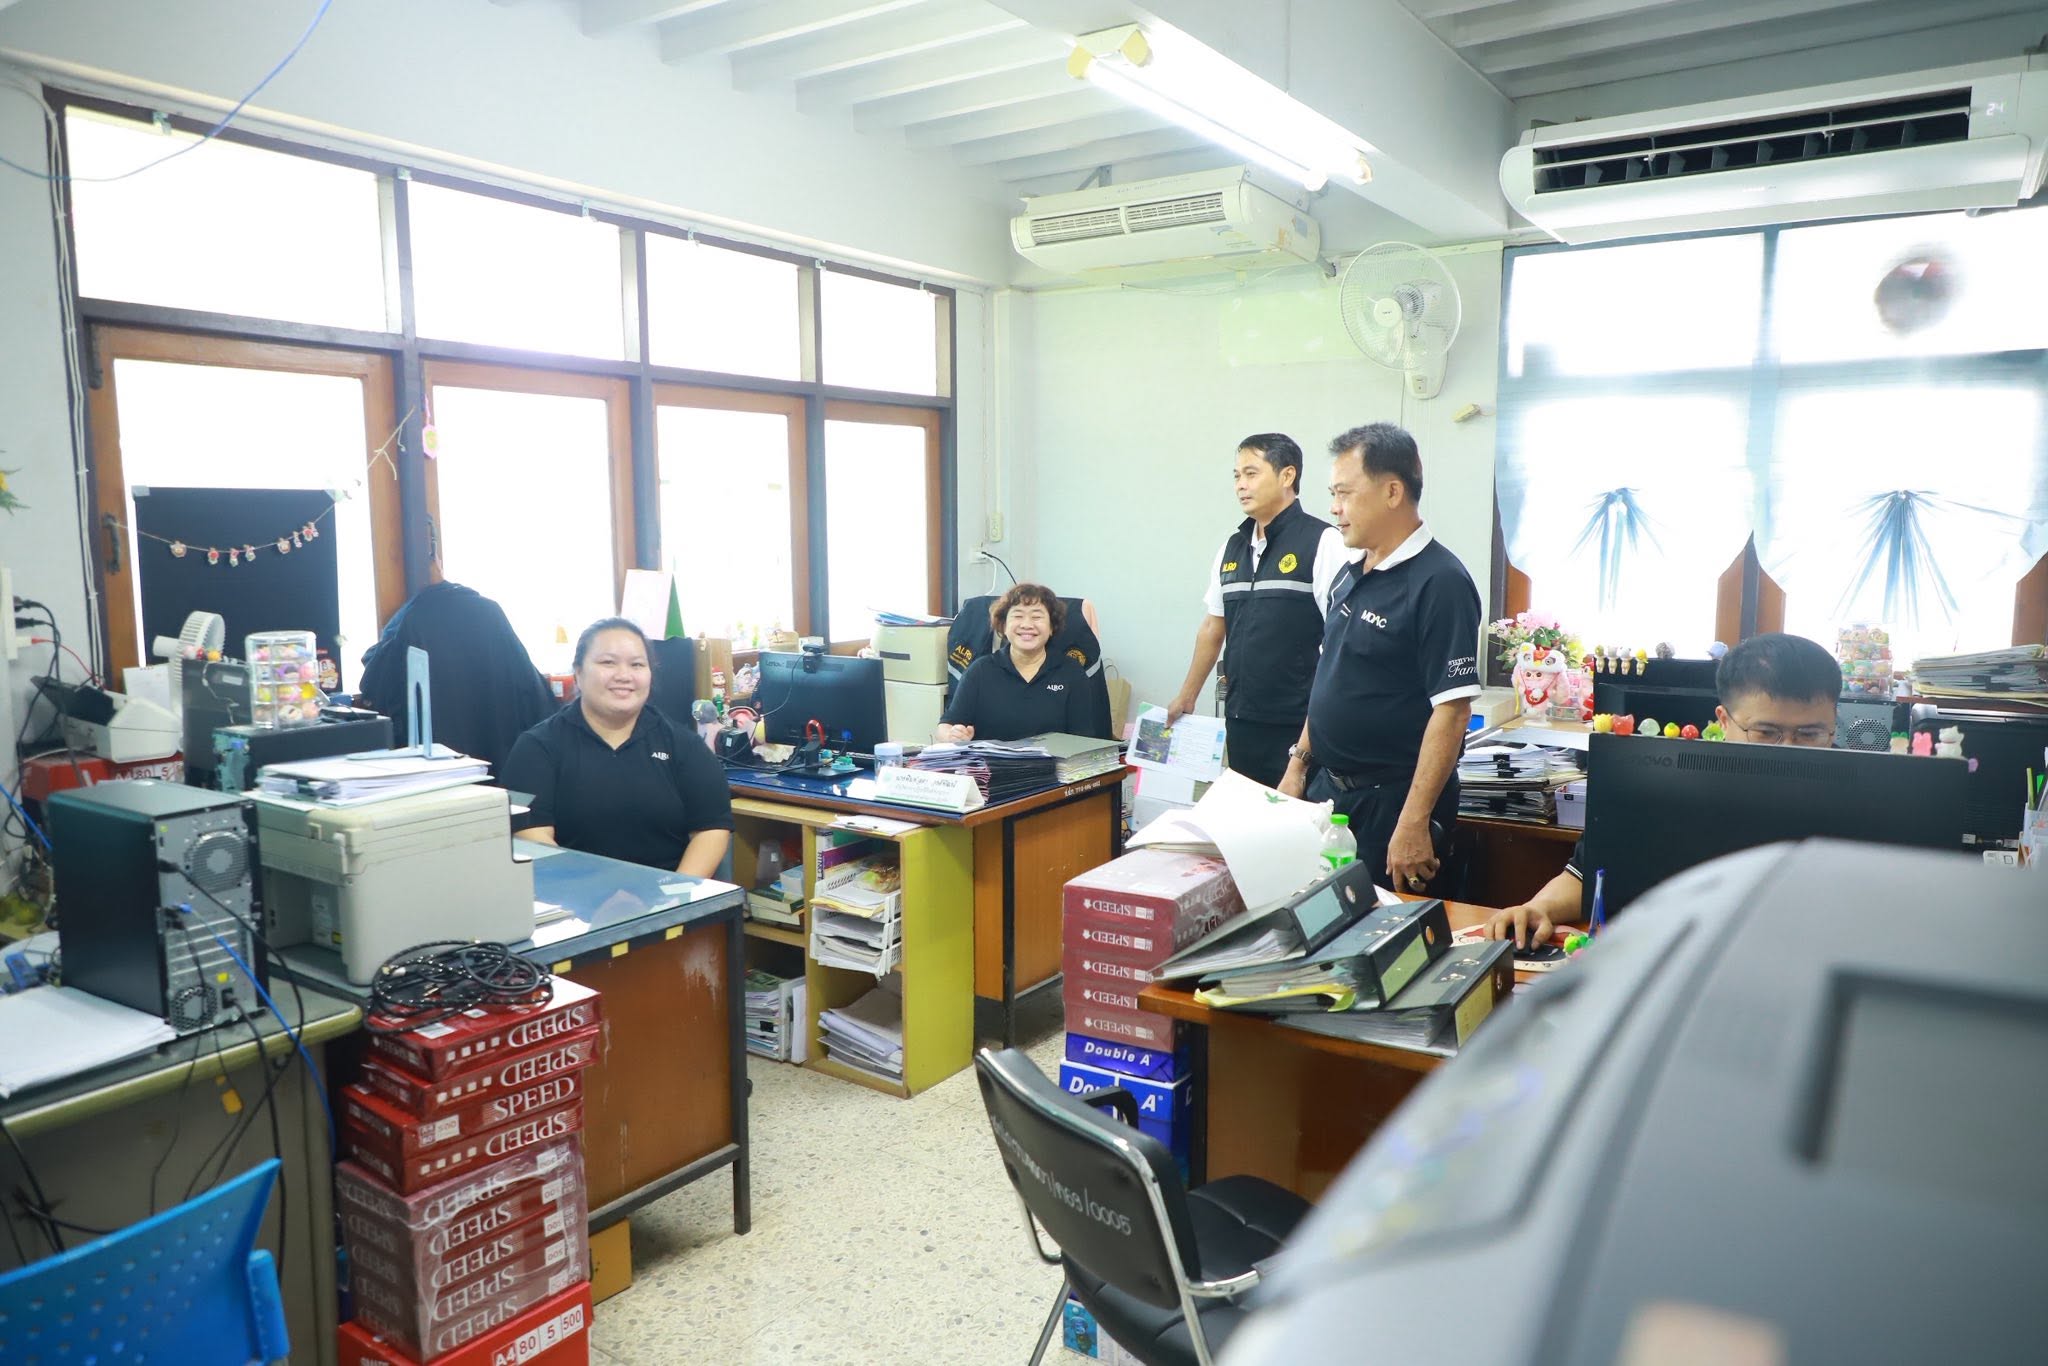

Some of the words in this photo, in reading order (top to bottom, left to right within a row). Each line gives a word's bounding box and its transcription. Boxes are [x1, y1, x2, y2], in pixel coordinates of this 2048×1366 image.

[1360, 609, 1387, 629] MOAC
[1092, 900, 1131, 912] SPEED
[1092, 931, 1129, 946] SPEED
[1092, 962, 1130, 977] SPEED
[1092, 990, 1130, 1008] SPEED
[508, 1005, 584, 1048] SPEED
[1093, 1018, 1131, 1035] SPEED
[501, 1044, 580, 1087] SPEED
[1084, 1042, 1135, 1062] Double
[493, 1077, 575, 1122] SPEED
[486, 1111, 568, 1156] SPEED
[430, 1201, 512, 1256] SPEED
[431, 1235, 513, 1289] SPEED
[433, 1265, 515, 1321] SPEED
[437, 1295, 517, 1352] SPEED
[520, 1336, 536, 1354] 80
[547, 1324, 555, 1339] 5
[563, 1310, 581, 1330] 500
